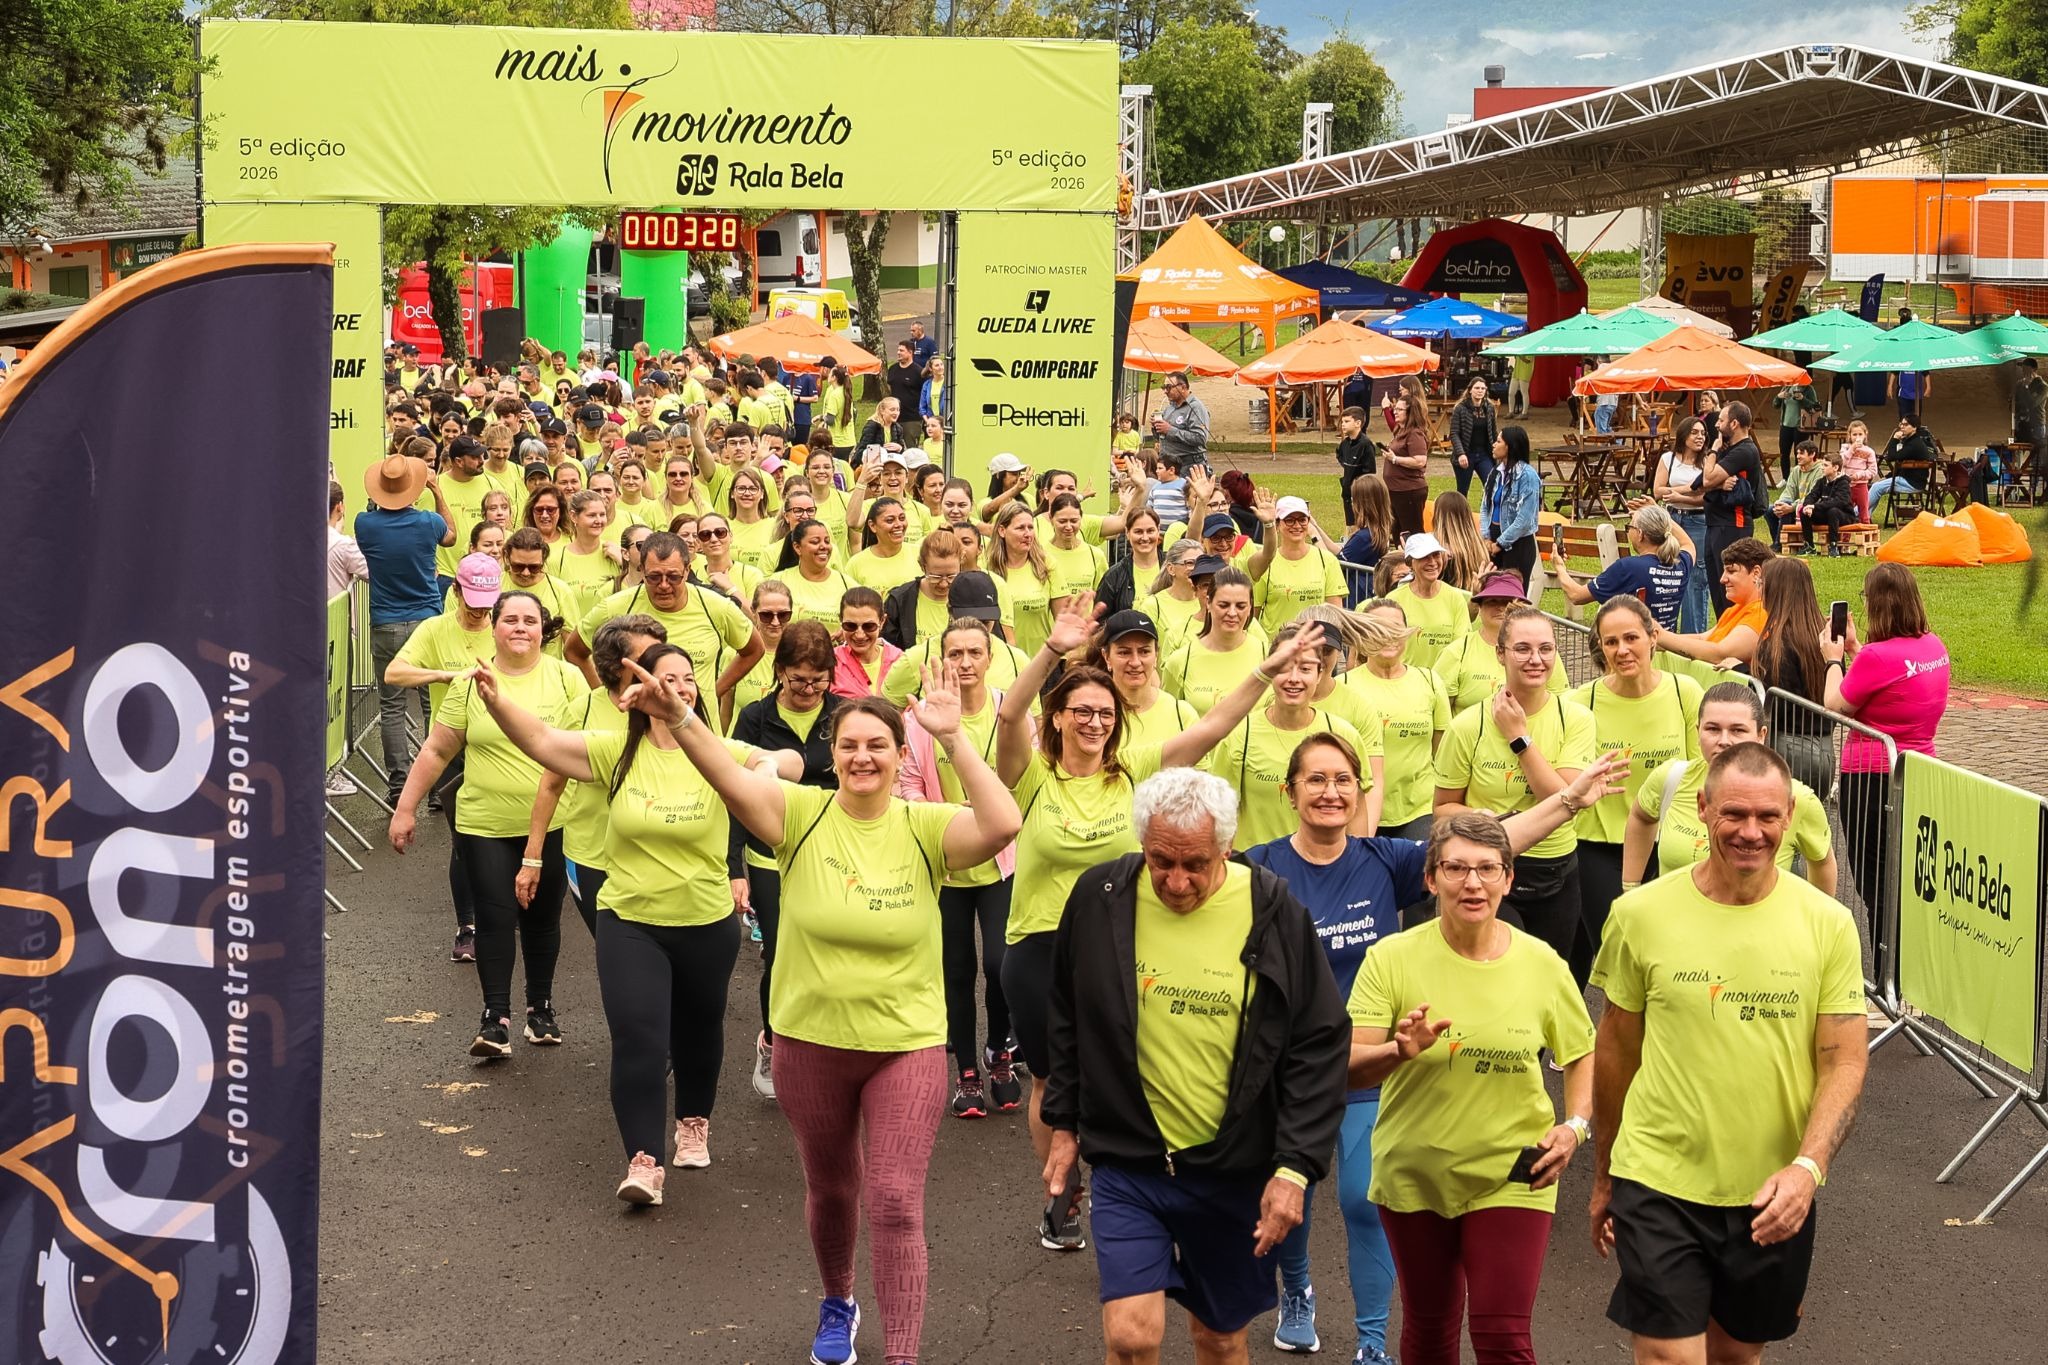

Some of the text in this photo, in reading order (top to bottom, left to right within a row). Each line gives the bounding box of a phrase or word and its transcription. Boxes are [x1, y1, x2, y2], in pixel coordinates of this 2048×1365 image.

[494, 44, 603, 82] mais
[632, 103, 853, 145] movimento
[239, 138, 346, 161] 5ª edição
[992, 150, 1087, 173] 5ª edição
[239, 166, 278, 180] 2026
[728, 162, 844, 192] Rala Bela
[1050, 177, 1085, 190] 2026
[624, 216, 737, 247] 000328
[985, 264, 1088, 276] PATROCÍNIO MASTER
[1445, 259, 1511, 276] belinha
[977, 317, 1096, 334] QUEDA LIVRE
[1010, 360, 1099, 379] COMPGRAF
[999, 403, 1086, 427] Pettenati
[1601, 740, 1624, 749] mais
[1632, 746, 1681, 761] movimento
[1482, 760, 1506, 770] mais
[1255, 771, 1280, 782] mais
[1673, 822, 1699, 838] mais
[1943, 840, 2013, 921] Rala Bela
[222, 650, 257, 1168] cronometragem esportiva
[1673, 969, 1711, 983] mais
[1153, 984, 1232, 1004] movimento
[1721, 989, 1800, 1005] movimento
[1188, 1004, 1229, 1017] Rala Bela
[1758, 1009, 1797, 1019] Rala Bela
[1460, 1046, 1530, 1061] movimento
[1493, 1064, 1528, 1074] Rala Bela
